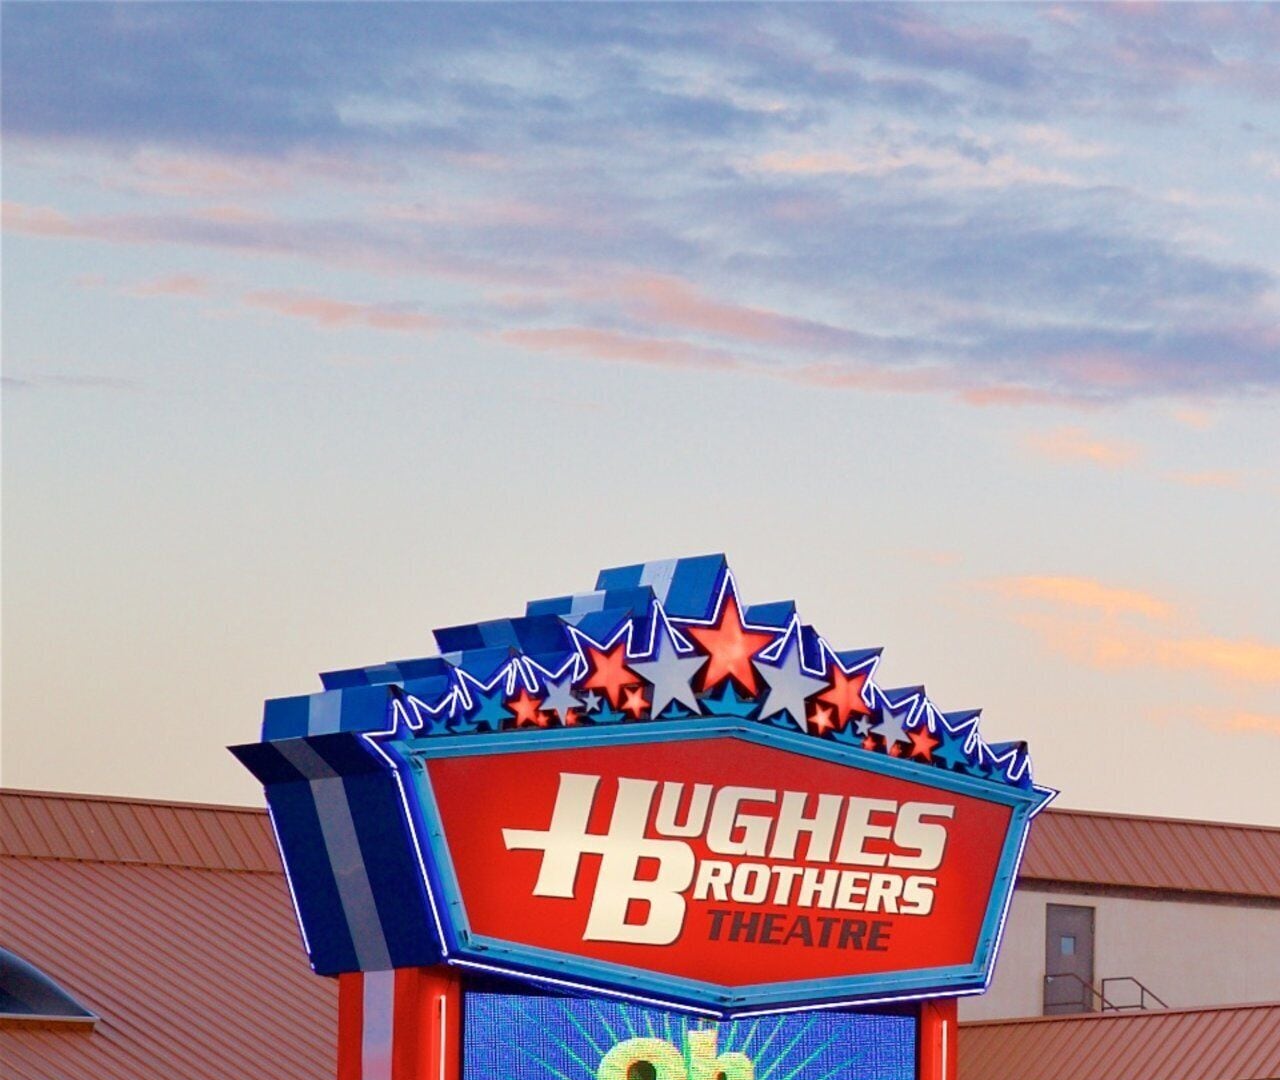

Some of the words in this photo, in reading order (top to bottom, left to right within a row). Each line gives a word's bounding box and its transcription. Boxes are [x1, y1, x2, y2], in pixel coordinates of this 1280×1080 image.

[502, 772, 955, 899] HUGHES
[583, 838, 937, 946] BROTHERS
[706, 908, 894, 952] THEATRE
